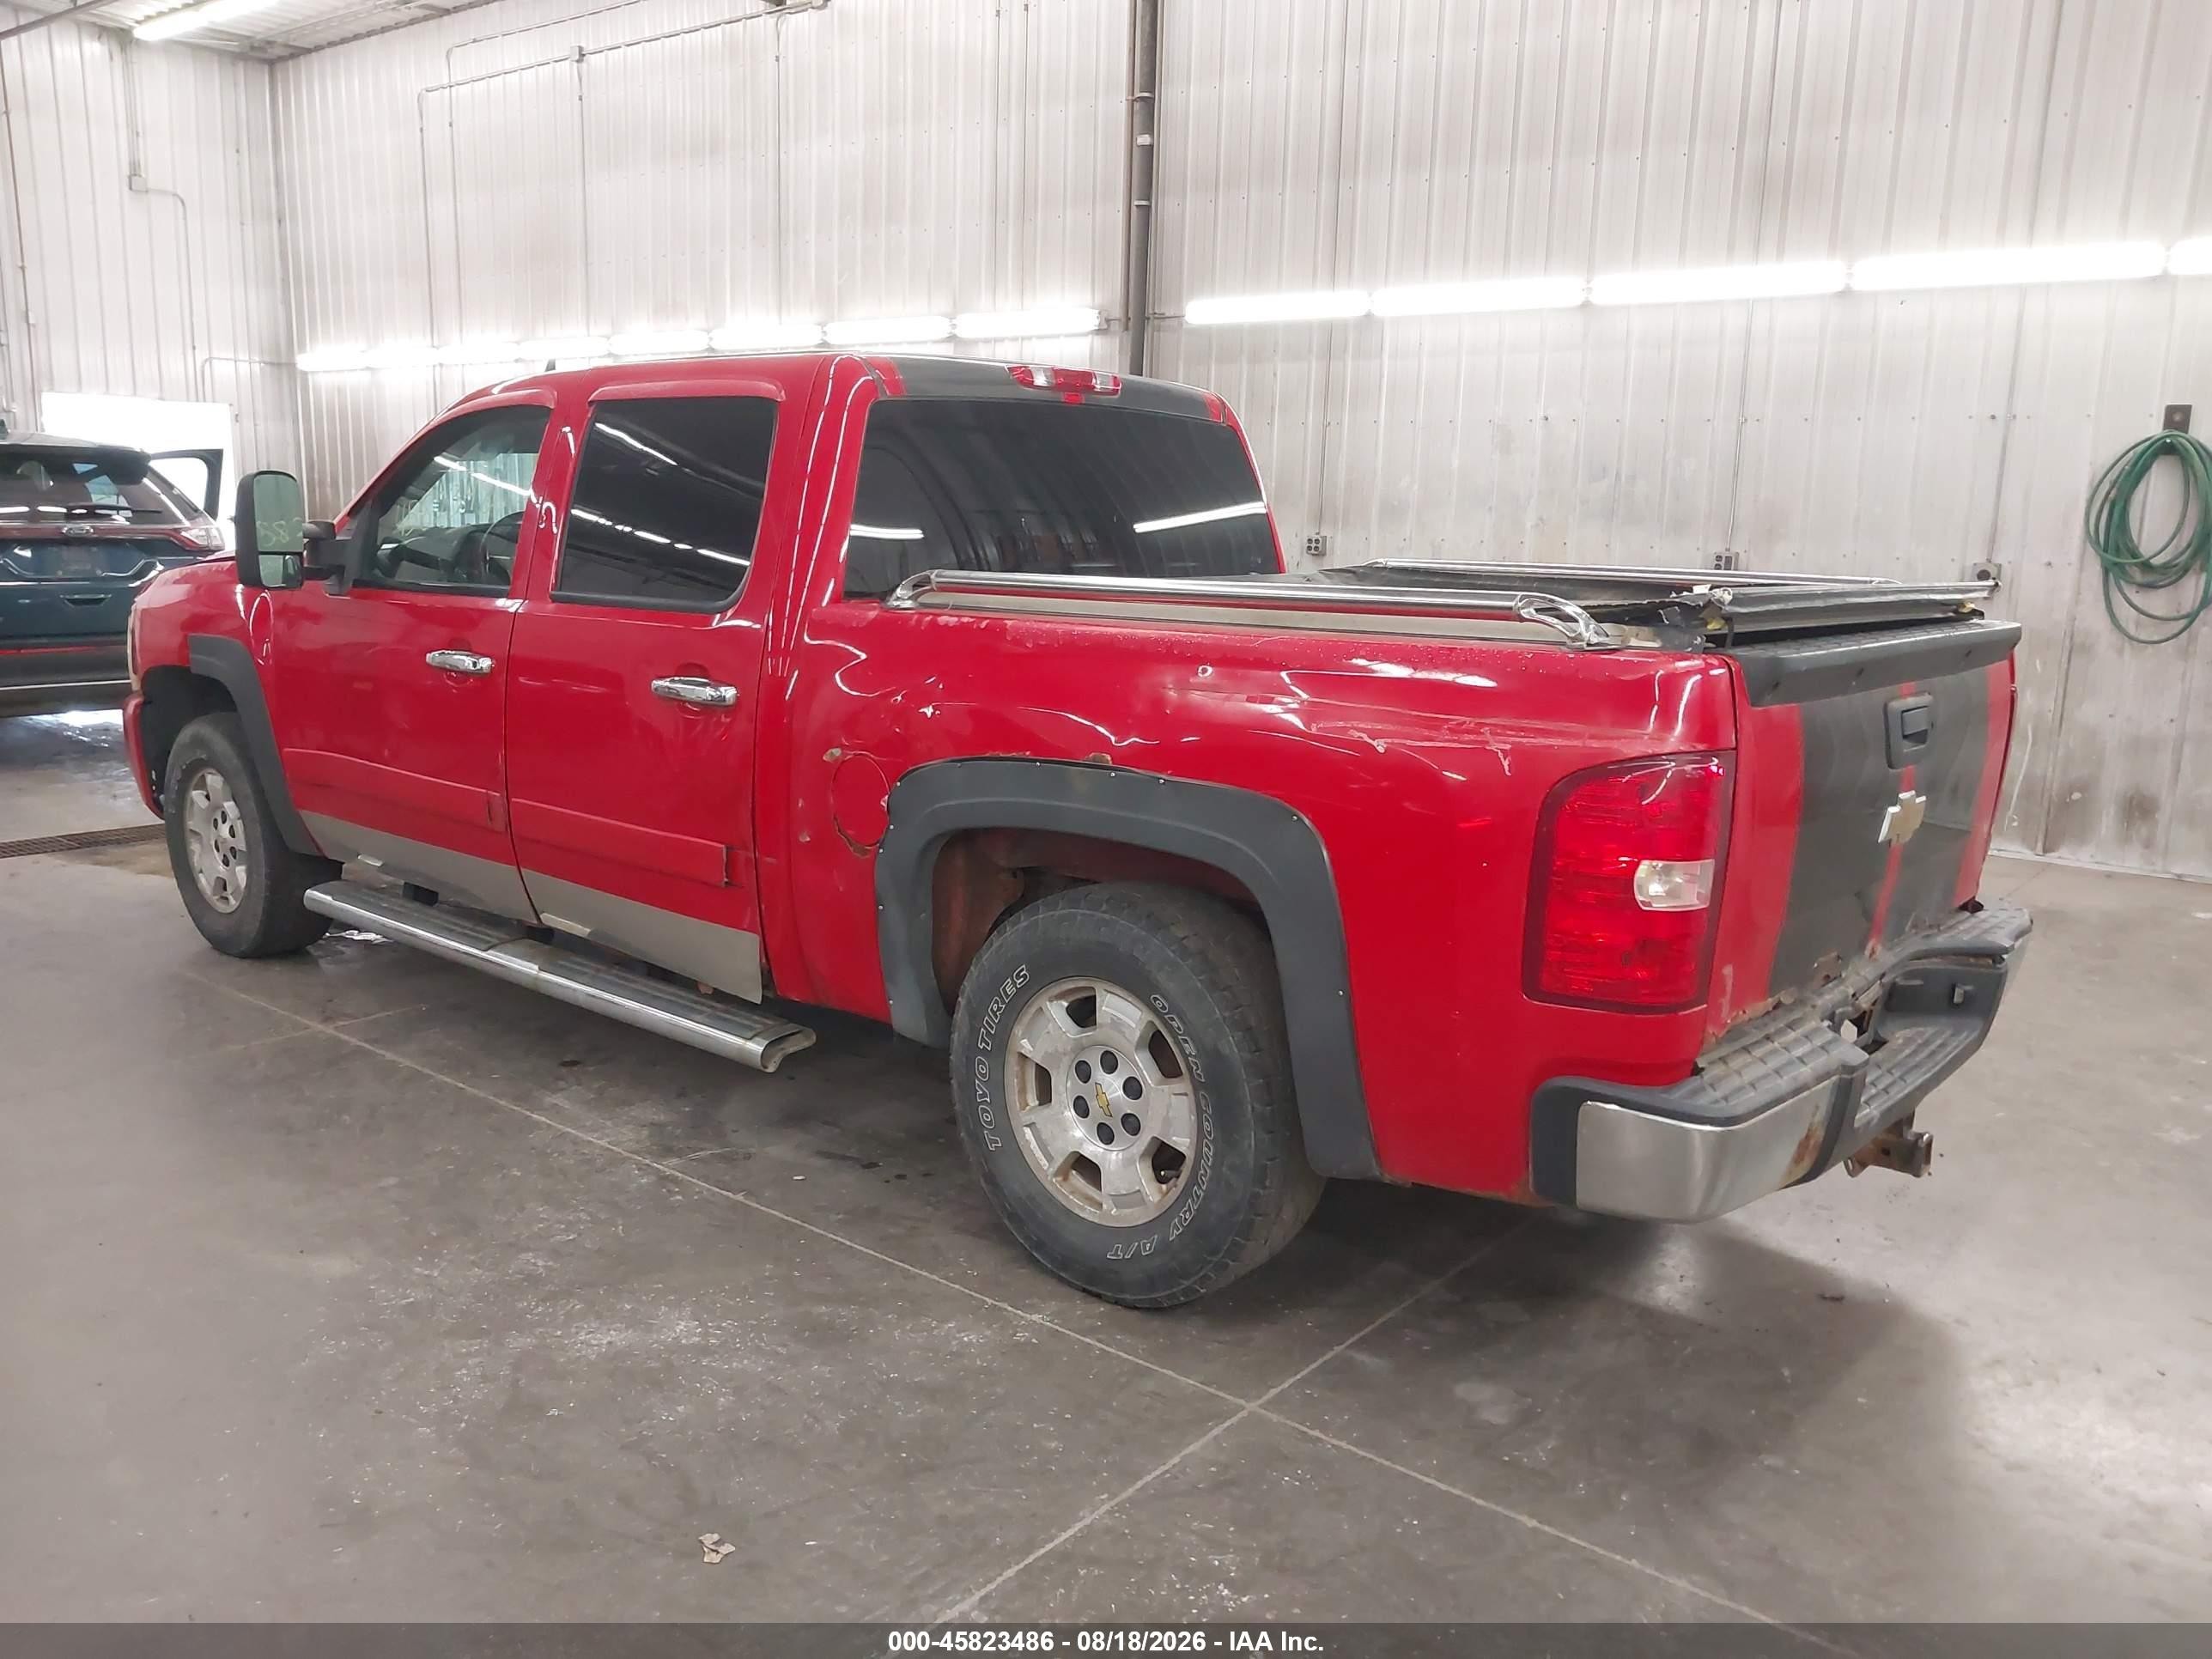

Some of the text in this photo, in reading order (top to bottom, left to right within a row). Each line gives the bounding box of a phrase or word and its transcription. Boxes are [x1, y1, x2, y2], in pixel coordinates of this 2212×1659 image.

[975, 963, 1030, 1152] TOYO TIRES
[1106, 994, 1214, 1260] OPEN COUNTRY A/T
